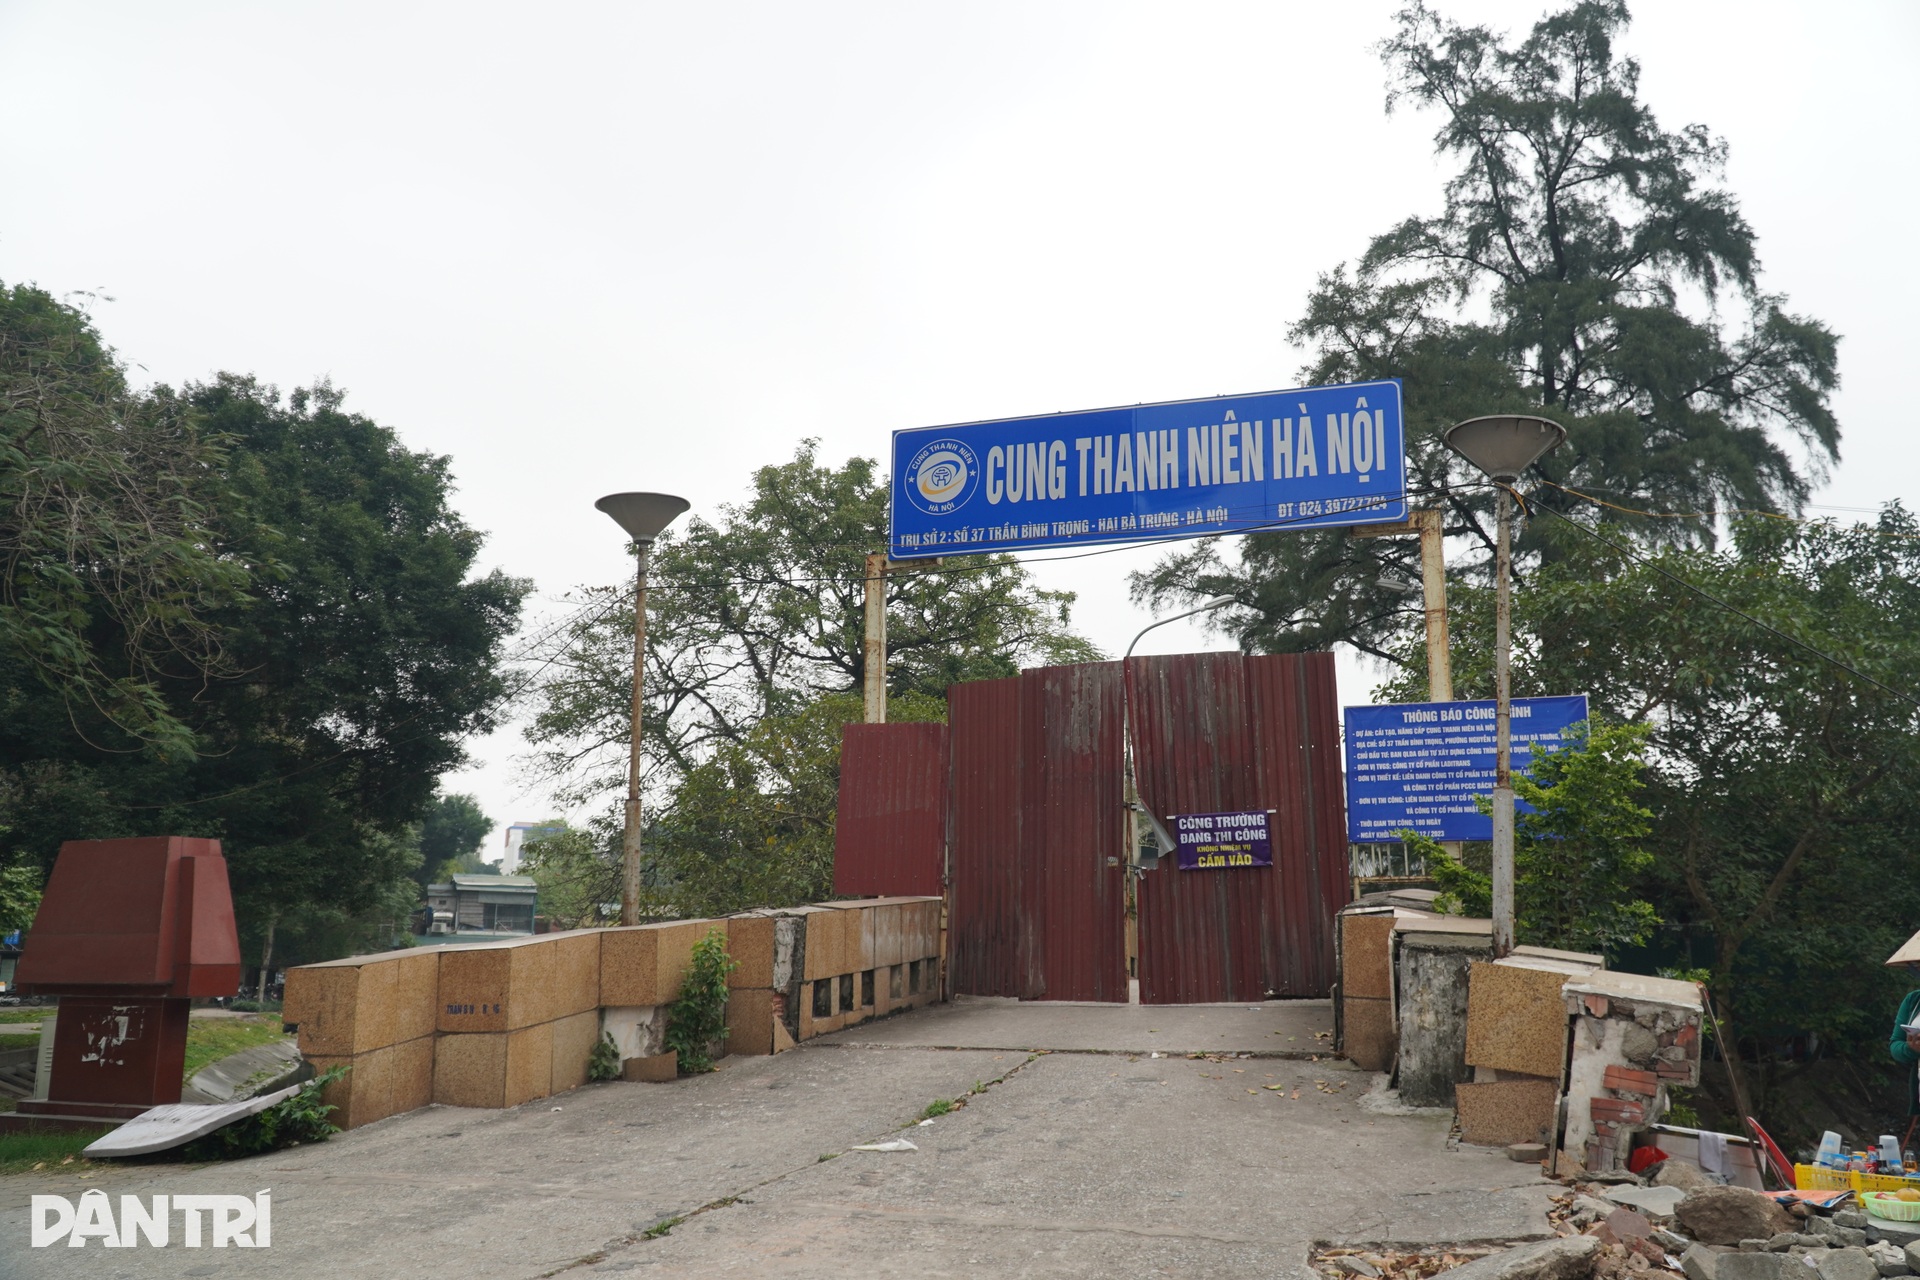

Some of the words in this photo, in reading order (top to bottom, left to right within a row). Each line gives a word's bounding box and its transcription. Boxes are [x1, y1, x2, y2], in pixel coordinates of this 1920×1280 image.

[911, 450, 930, 470] CUNG
[929, 442, 958, 453] THANH
[958, 447, 974, 465] NIÊN
[986, 440, 1066, 505] CUNG
[1076, 429, 1179, 496] THANH
[1188, 410, 1264, 487] NIÊN
[1272, 403, 1318, 479] HÀ
[1327, 397, 1386, 483] NỘI
[928, 504, 939, 512] HÀ
[941, 502, 955, 512] NỘI
[1299, 500, 1322, 517] 024
[1325, 495, 1388, 515] 39727724
[900, 533, 920, 550] TRỤ
[923, 529, 938, 546] SỞ
[954, 525, 969, 543] SỐ
[971, 528, 984, 542] 37
[988, 521, 1018, 541] TRẦN
[1021, 521, 1048, 538] BÌNH
[1051, 519, 1089, 538] TRỌNG
[1098, 516, 1118, 532] HAI
[1121, 512, 1137, 530] BÀ
[1139, 511, 1179, 529] TRƯNG
[1186, 507, 1204, 525] HÀ
[1206, 505, 1228, 526] NỘI
[1402, 709, 1438, 723] THÔNG
[1440, 707, 1463, 722] BÁO
[1465, 706, 1496, 720] CÔNG
[1414, 725, 1425, 735] CẤP
[1426, 726, 1441, 734] CUNG
[1442, 725, 1460, 733] THANH
[1461, 724, 1475, 732] NIÊN
[1476, 723, 1484, 732] HÀ
[1485, 723, 1495, 732] NỘI
[1378, 739, 1386, 747] SỐ
[1530, 733, 1538, 741] BÀ
[1438, 748, 1449, 756] XÂY
[1466, 747, 1482, 755] CÔNG
[1392, 761, 1407, 769] CÔNG
[1408, 761, 1415, 769] TY
[1415, 772, 1430, 780] DANH
[1431, 771, 1447, 779] CÔNG
[1378, 796, 1387, 804] THI
[1434, 794, 1450, 802] CÔNG
[1414, 806, 1430, 814] CÔNG
[1179, 815, 1213, 830] CÔNG
[1215, 813, 1266, 828] TRƯỜNG
[1426, 817, 1441, 826] NGÀY
[1180, 832, 1212, 844] ĐANG
[1214, 831, 1232, 843] THI
[1235, 828, 1267, 841] CÔNG
[1361, 831, 1375, 839] NGÀY
[1196, 843, 1219, 853] KHÔNG
[1220, 843, 1241, 852] NHIỆM
[1242, 843, 1252, 853] VỤ
[1198, 852, 1225, 868] CẤM
[1228, 852, 1253, 867] VÀO
